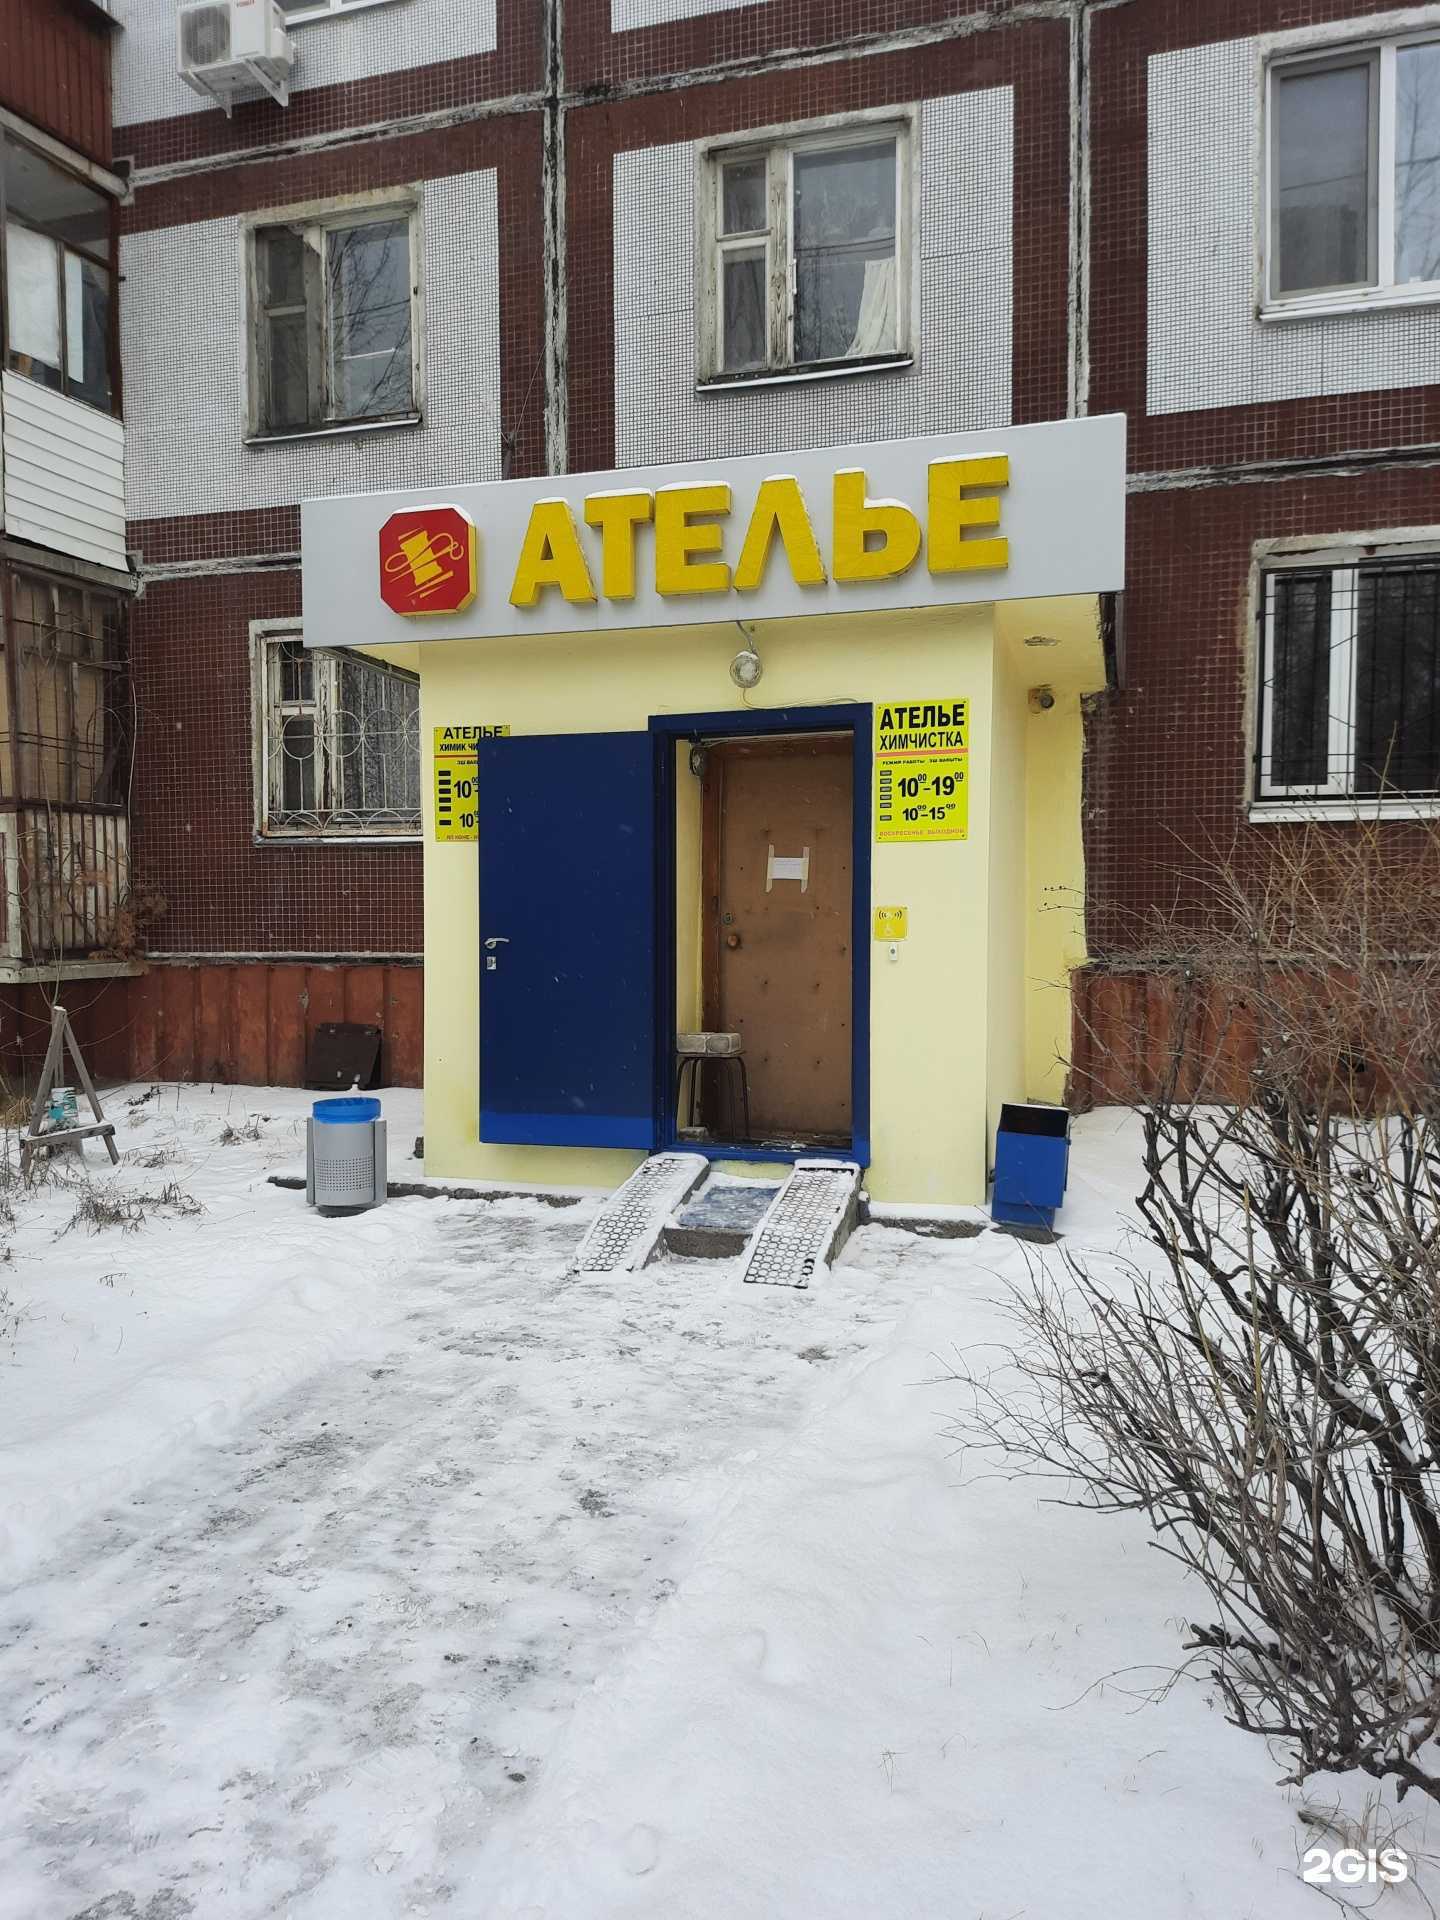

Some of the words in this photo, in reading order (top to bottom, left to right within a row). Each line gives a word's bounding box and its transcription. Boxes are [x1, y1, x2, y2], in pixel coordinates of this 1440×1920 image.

[509, 453, 1010, 608] АТЕЛЬЕ
[880, 703, 965, 730] АТЕЛЬЕ
[443, 725, 503, 739] АТЕЛЬЕ
[880, 730, 964, 751] ХИМЧИСТКА
